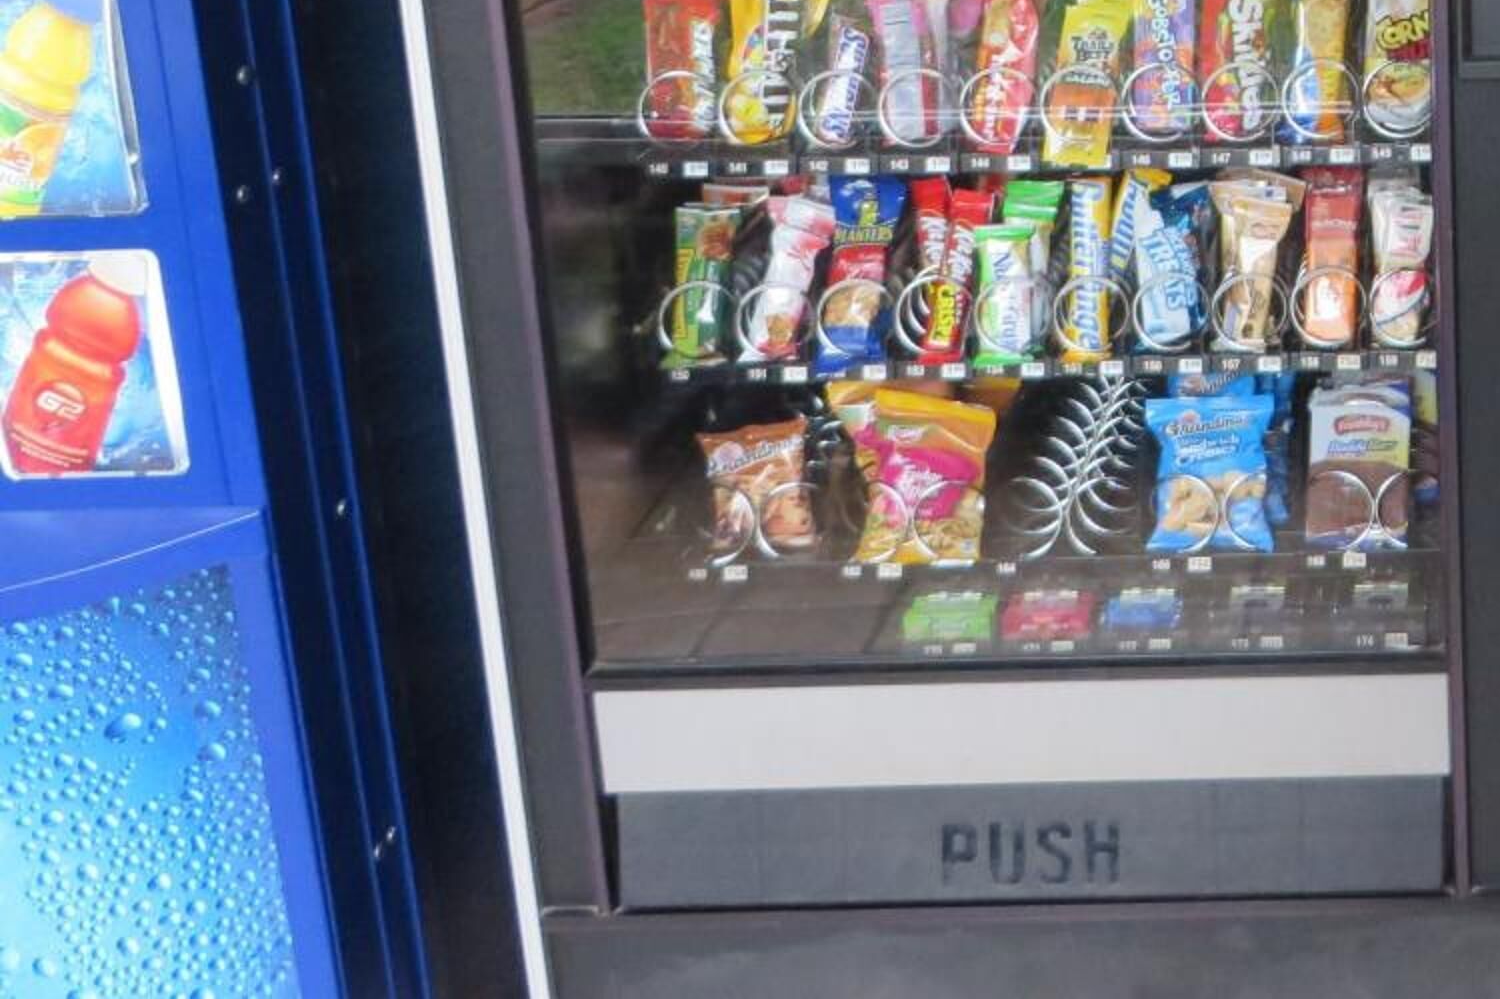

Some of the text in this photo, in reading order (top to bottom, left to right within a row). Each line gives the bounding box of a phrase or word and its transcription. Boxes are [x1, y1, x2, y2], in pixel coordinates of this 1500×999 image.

[1376, 11, 1429, 51] CORN
[1211, 152, 1231, 164] 147
[37, 389, 85, 420] G2
[940, 820, 1121, 885] PUSH
